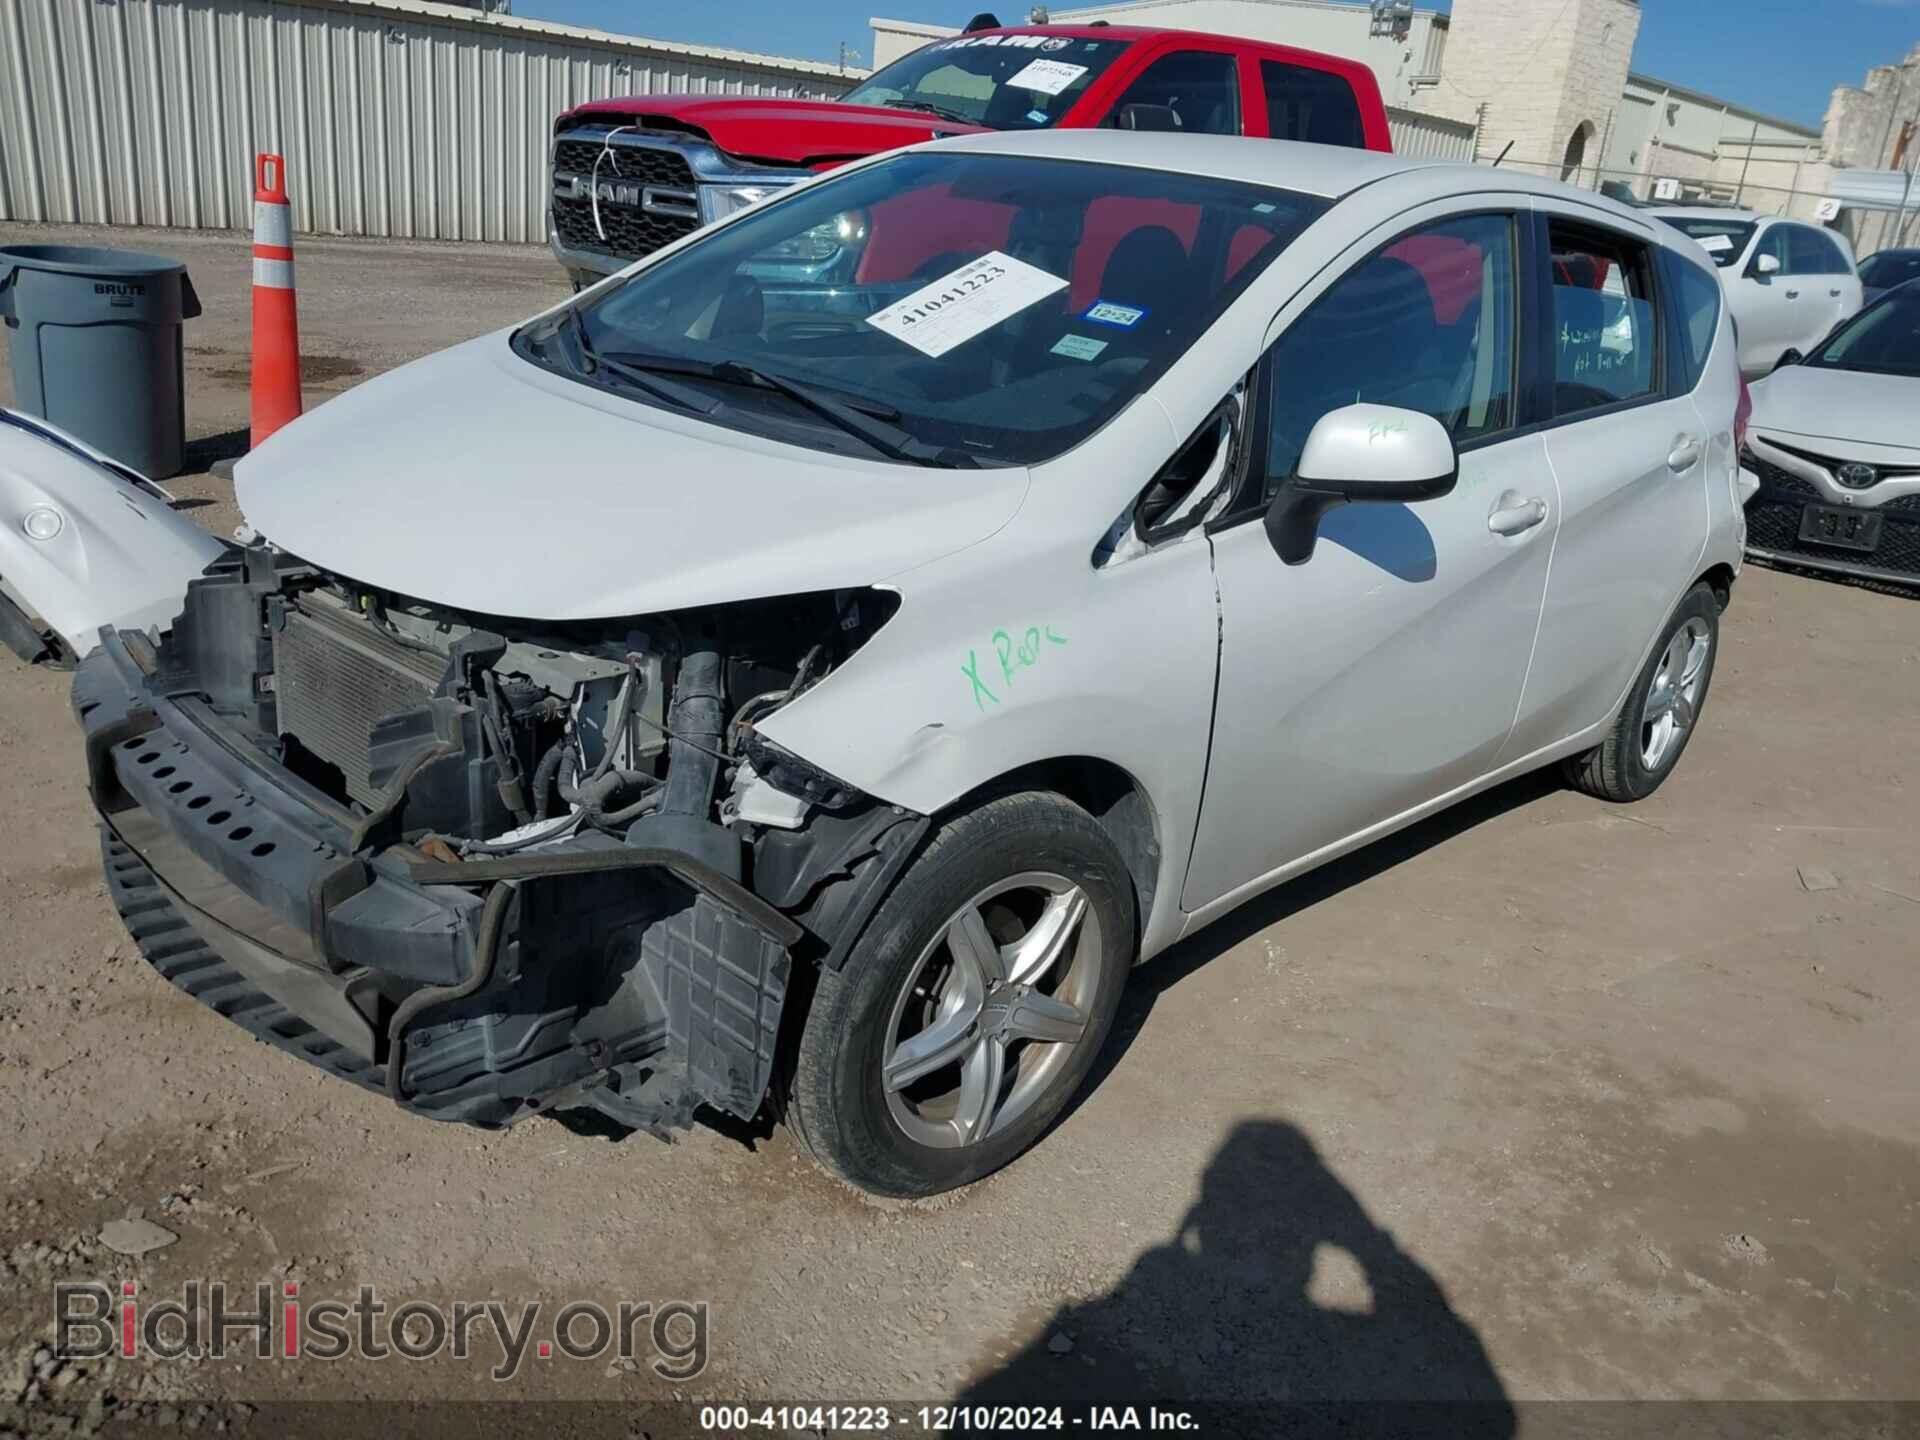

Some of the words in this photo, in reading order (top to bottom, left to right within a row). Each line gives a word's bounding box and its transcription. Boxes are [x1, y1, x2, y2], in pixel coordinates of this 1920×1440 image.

[942, 35, 1049, 51] RAM
[1821, 202, 1834, 216] 2
[94, 283, 145, 297] BRUTE
[901, 265, 1006, 327] 41041223
